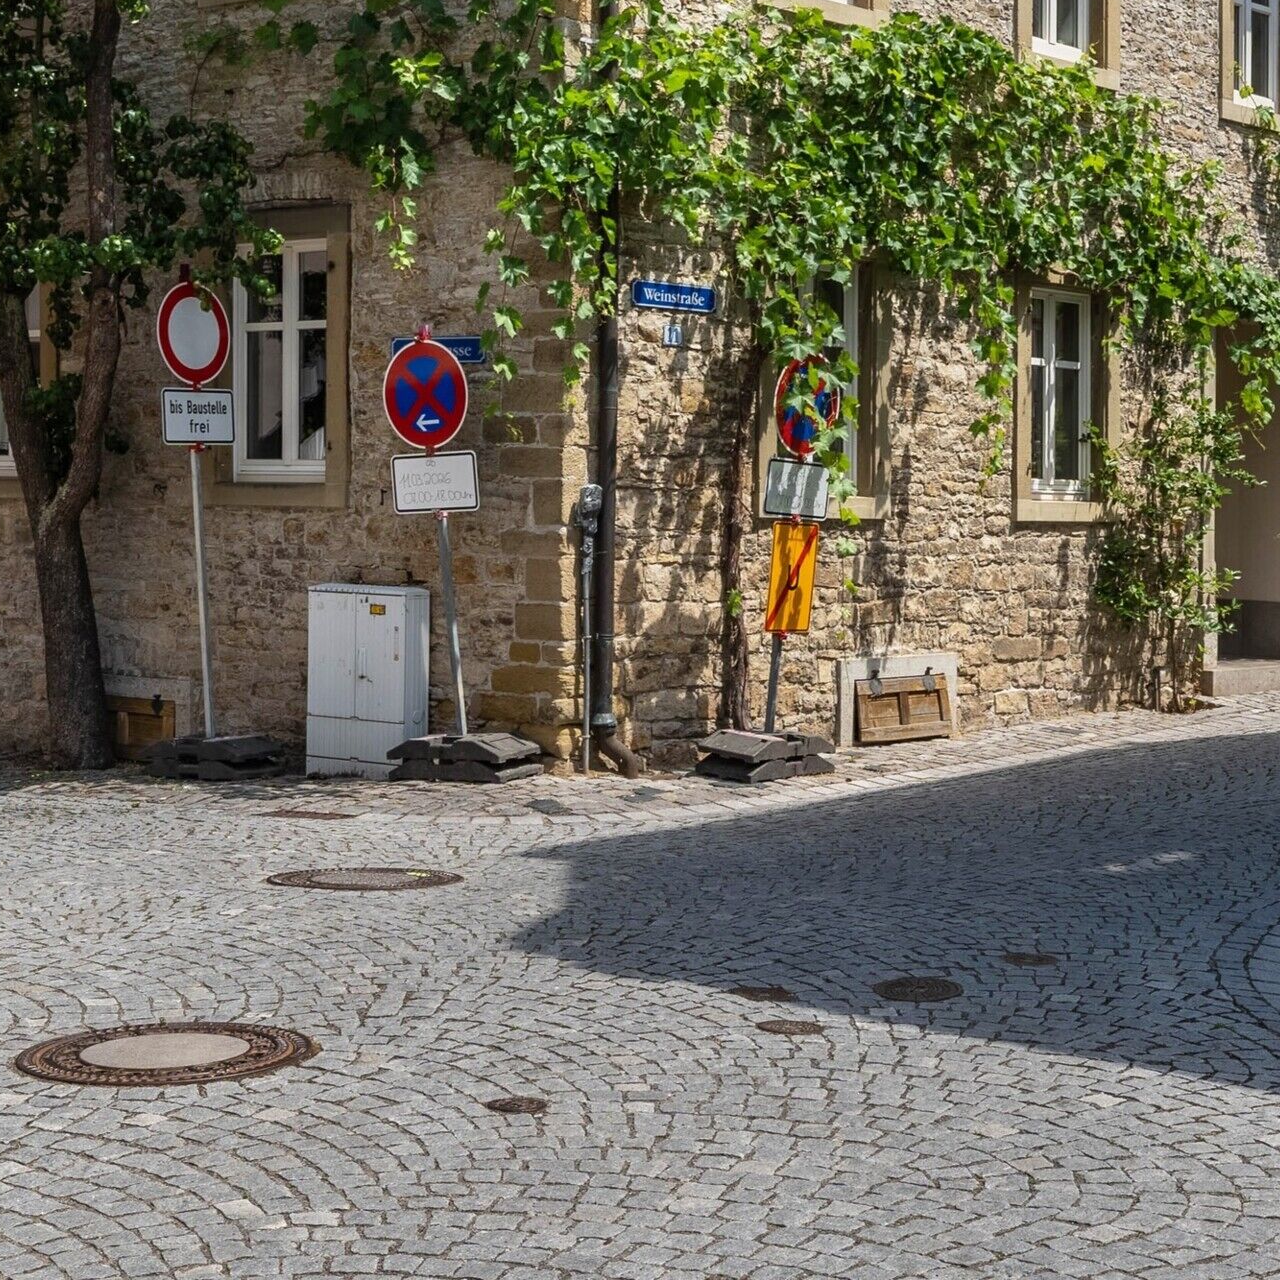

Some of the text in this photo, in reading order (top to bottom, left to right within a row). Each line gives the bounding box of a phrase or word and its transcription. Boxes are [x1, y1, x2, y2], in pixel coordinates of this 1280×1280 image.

[643, 287, 705, 306] Weinstraße
[169, 400, 228, 415] bis Baustelle
[189, 419, 210, 433] frei
[787, 564, 800, 591] U
